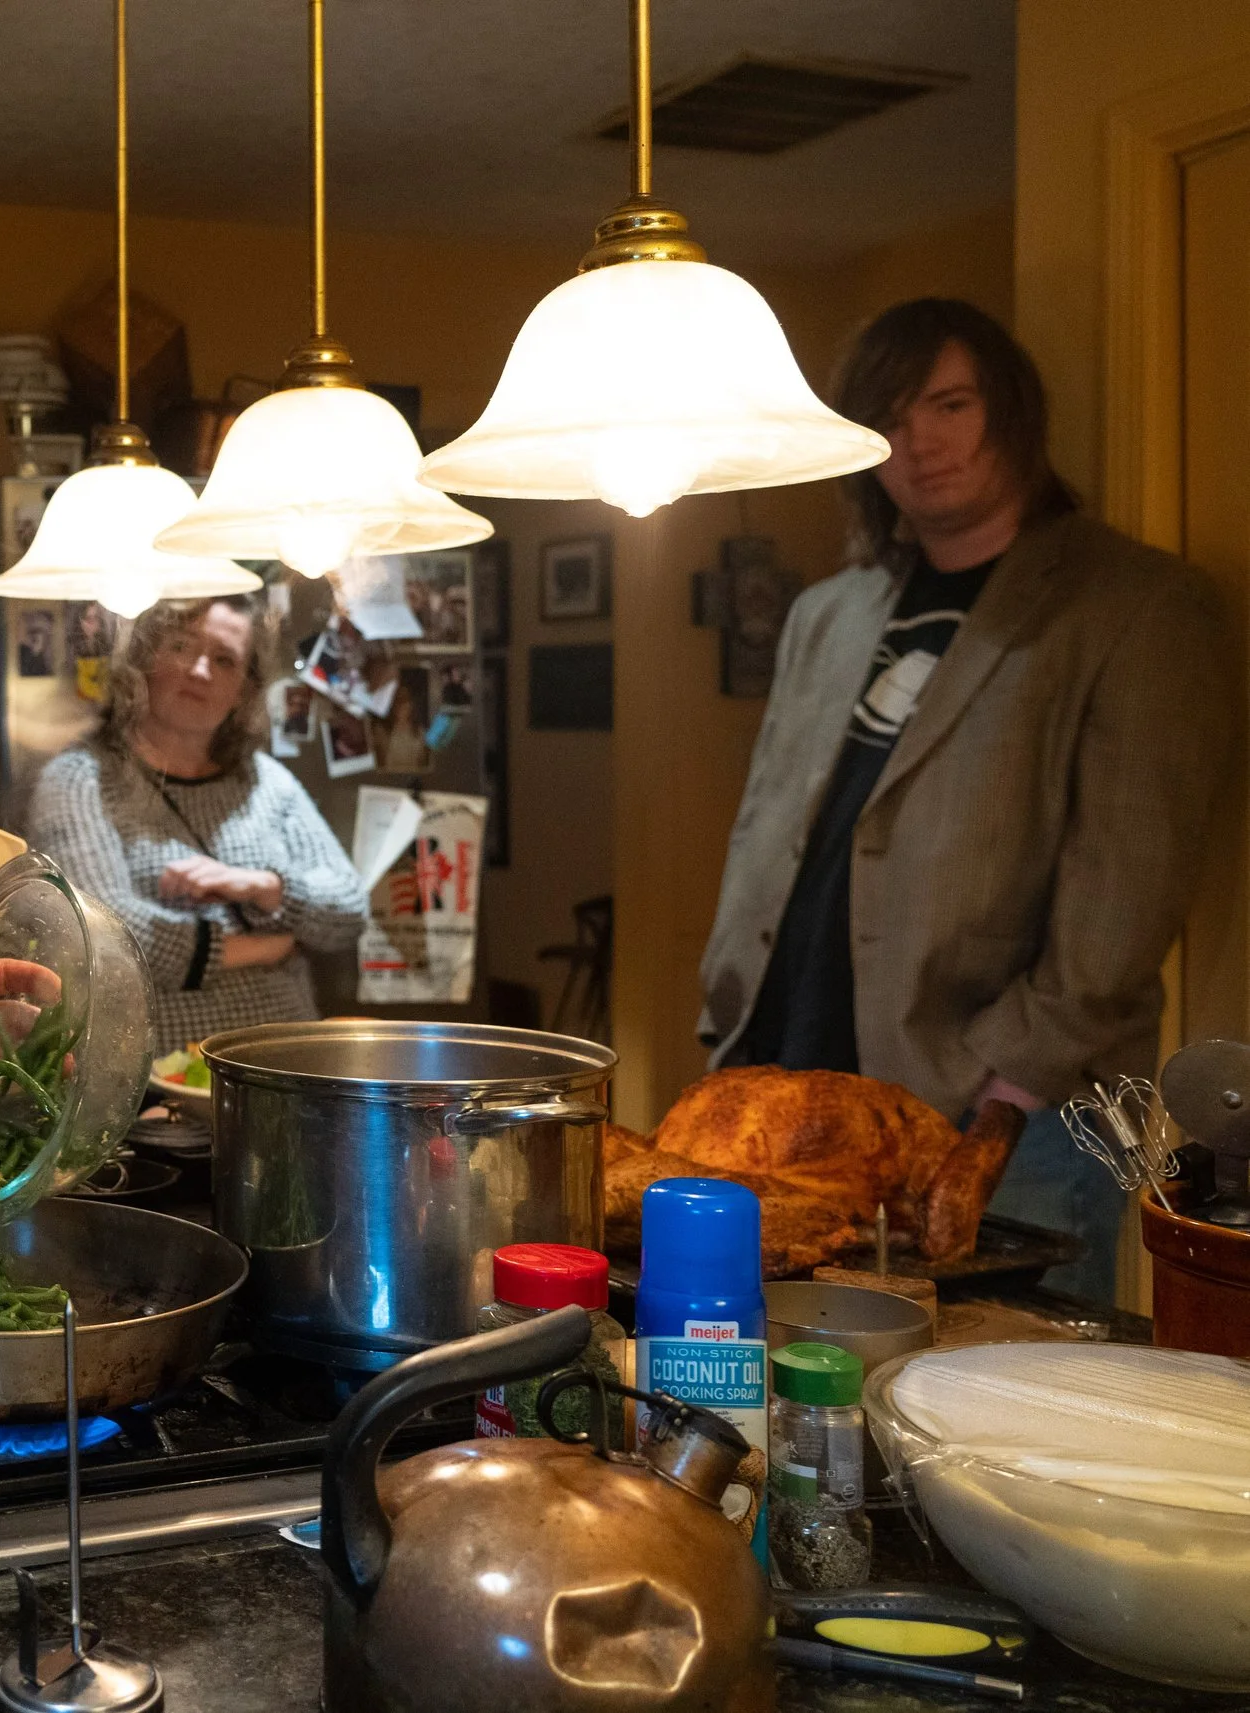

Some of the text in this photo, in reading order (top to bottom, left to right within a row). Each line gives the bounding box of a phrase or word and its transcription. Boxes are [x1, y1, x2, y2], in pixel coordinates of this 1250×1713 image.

[690, 1325, 735, 1342] meijer
[666, 1347, 753, 1359] NON-STICK
[652, 1358, 763, 1385] COCONUT OIL
[726, 1387, 759, 1401] SPRAY
